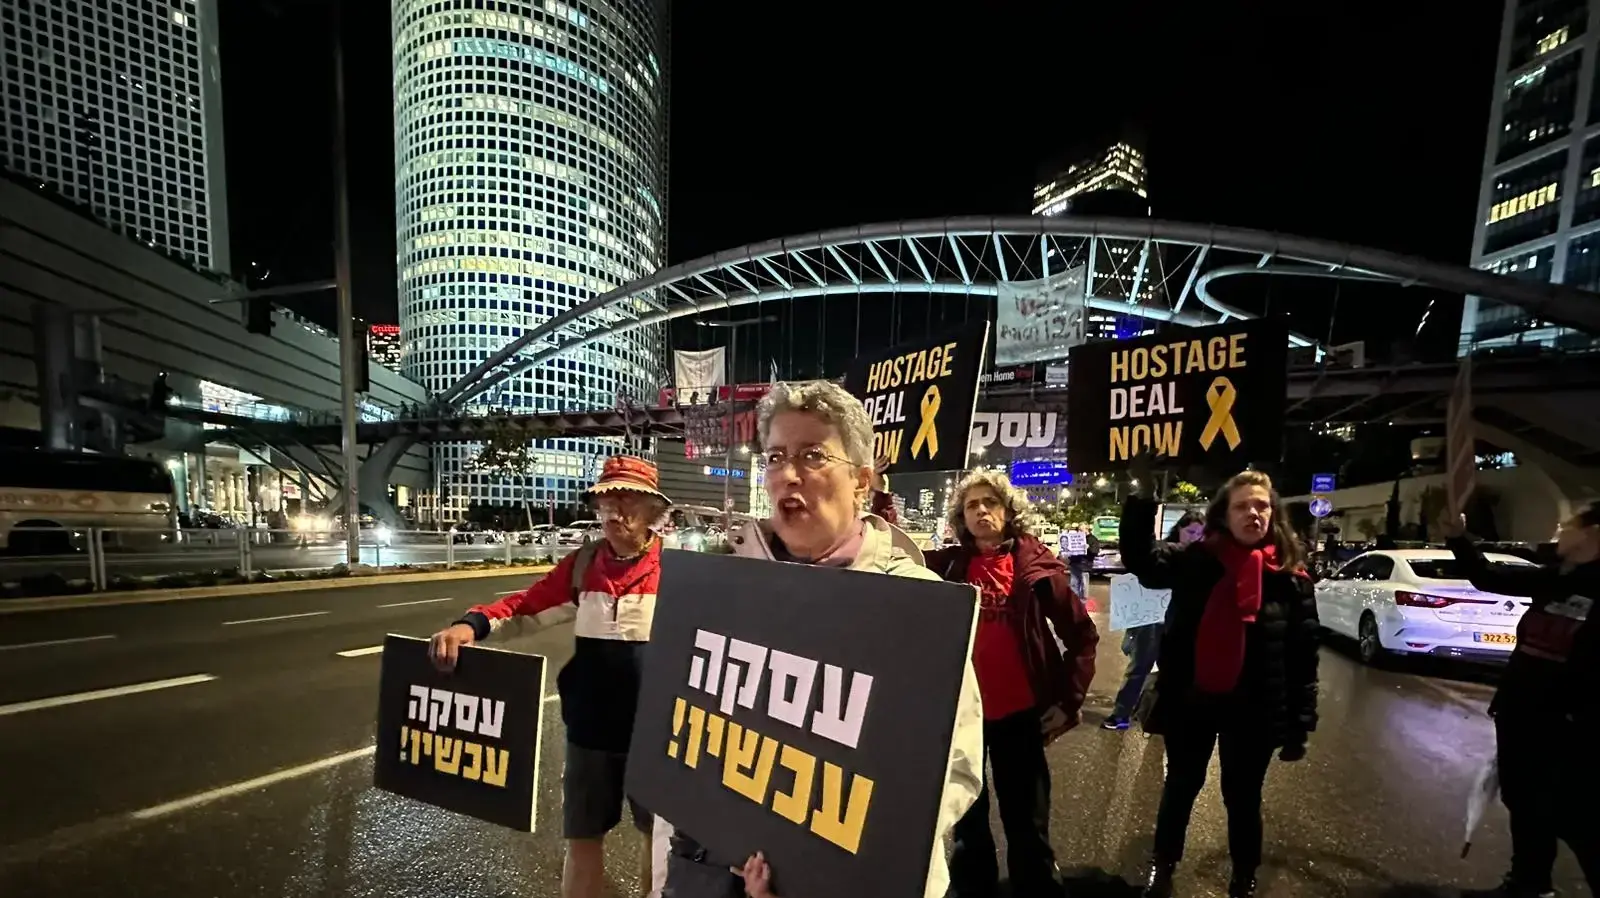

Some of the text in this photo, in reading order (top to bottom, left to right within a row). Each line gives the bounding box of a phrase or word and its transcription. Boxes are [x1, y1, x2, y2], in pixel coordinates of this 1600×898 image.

[867, 342, 957, 393] HOSTAGE
[993, 370, 1015, 382] Home
[1111, 333, 1248, 383] HOSTAGE
[1110, 381, 1184, 420] DEAL
[873, 429, 904, 464] OW
[971, 412, 1058, 454] עסק
[1109, 421, 1183, 461] NOW
[407, 685, 505, 739] עסקה
[689, 629, 874, 749] עסקה
[400, 726, 510, 788] עכשיו!
[667, 697, 874, 855] עכשיו!
